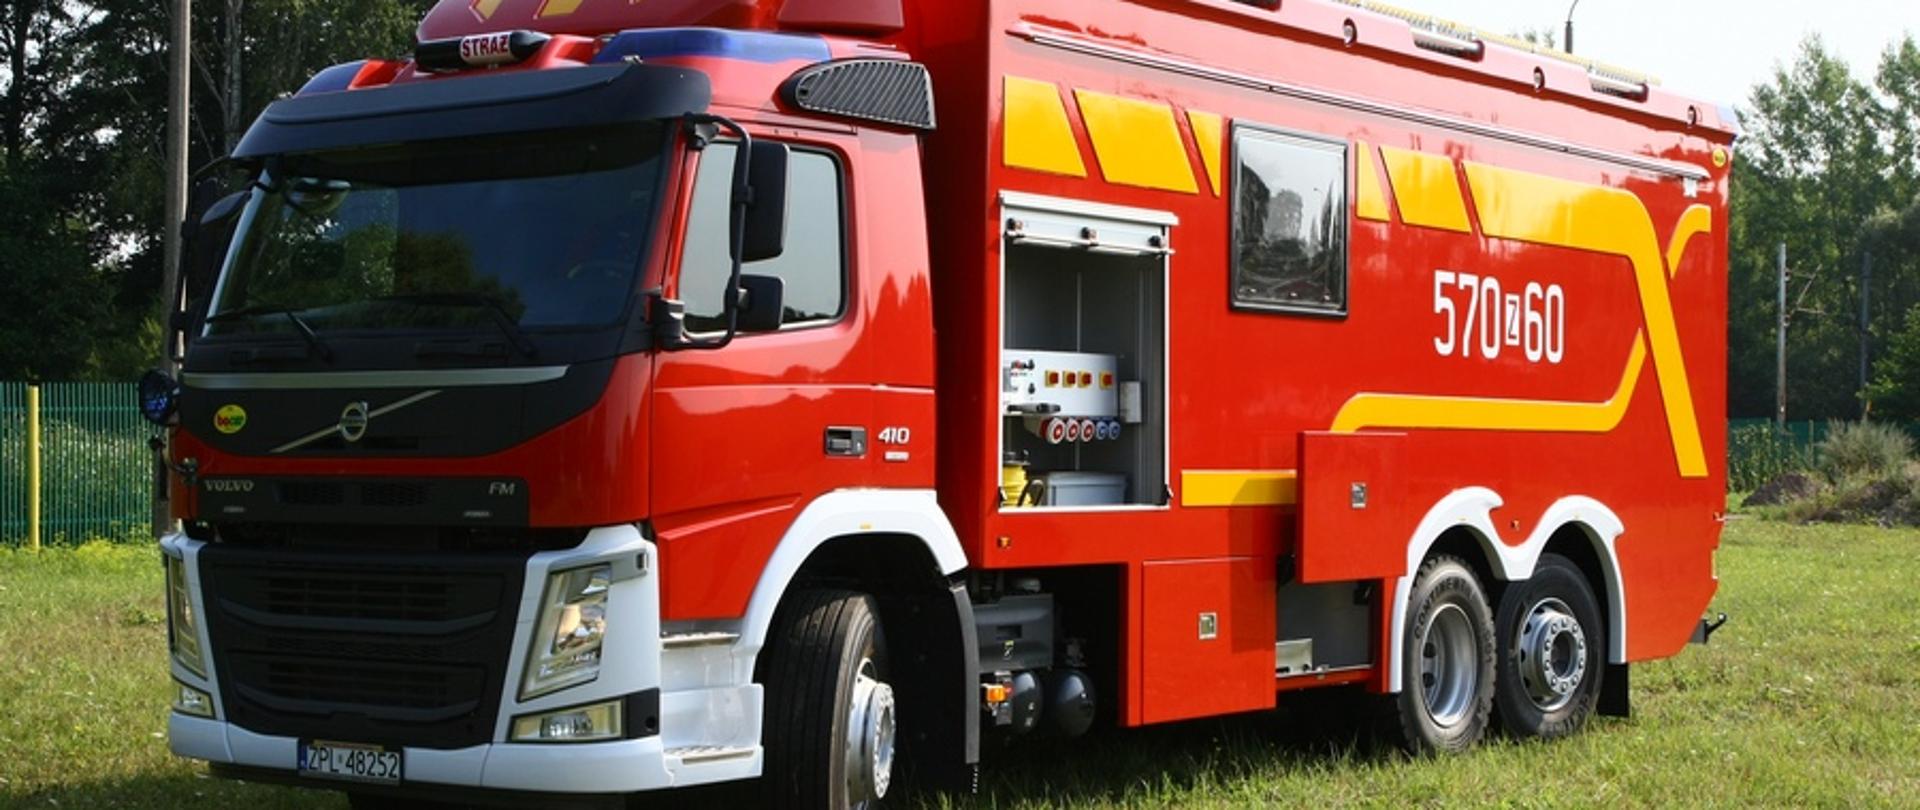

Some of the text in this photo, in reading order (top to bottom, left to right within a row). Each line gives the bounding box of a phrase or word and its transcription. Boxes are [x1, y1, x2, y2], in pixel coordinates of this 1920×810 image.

[878, 426, 910, 444] 410
[204, 479, 255, 492] VOLVO
[488, 481, 516, 496] FM
[345, 750, 398, 778] 48252
